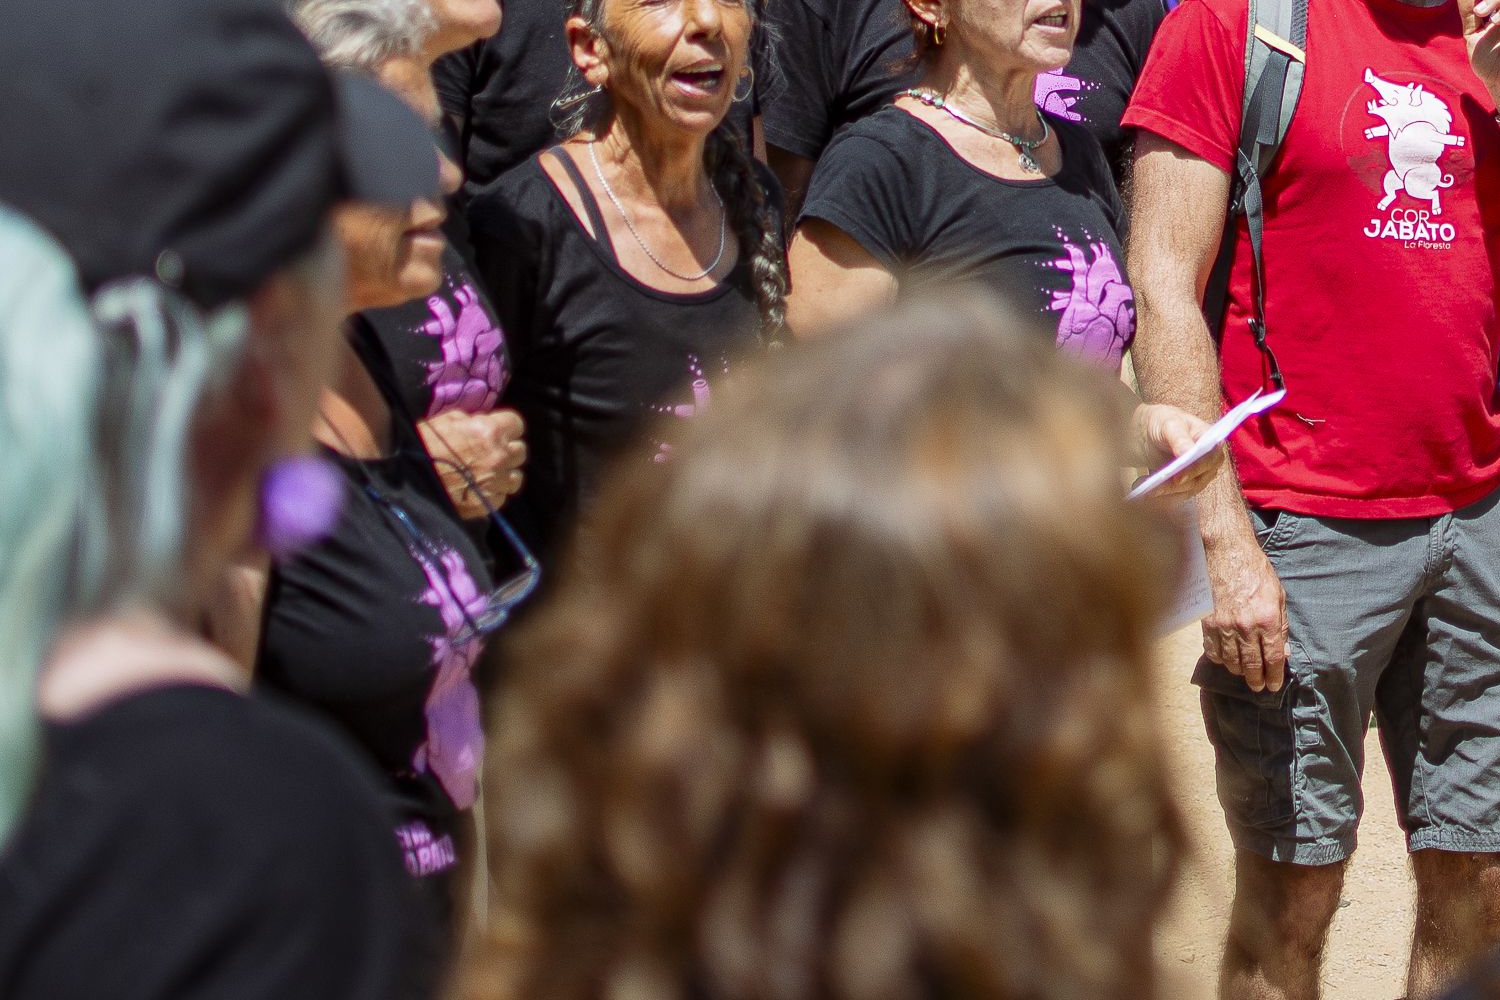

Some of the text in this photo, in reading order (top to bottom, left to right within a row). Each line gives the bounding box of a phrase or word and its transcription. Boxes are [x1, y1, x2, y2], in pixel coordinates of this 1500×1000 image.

[1391, 208, 1430, 225] COR
[1363, 219, 1456, 242] JABATO
[1404, 241, 1451, 250] La Floresta
